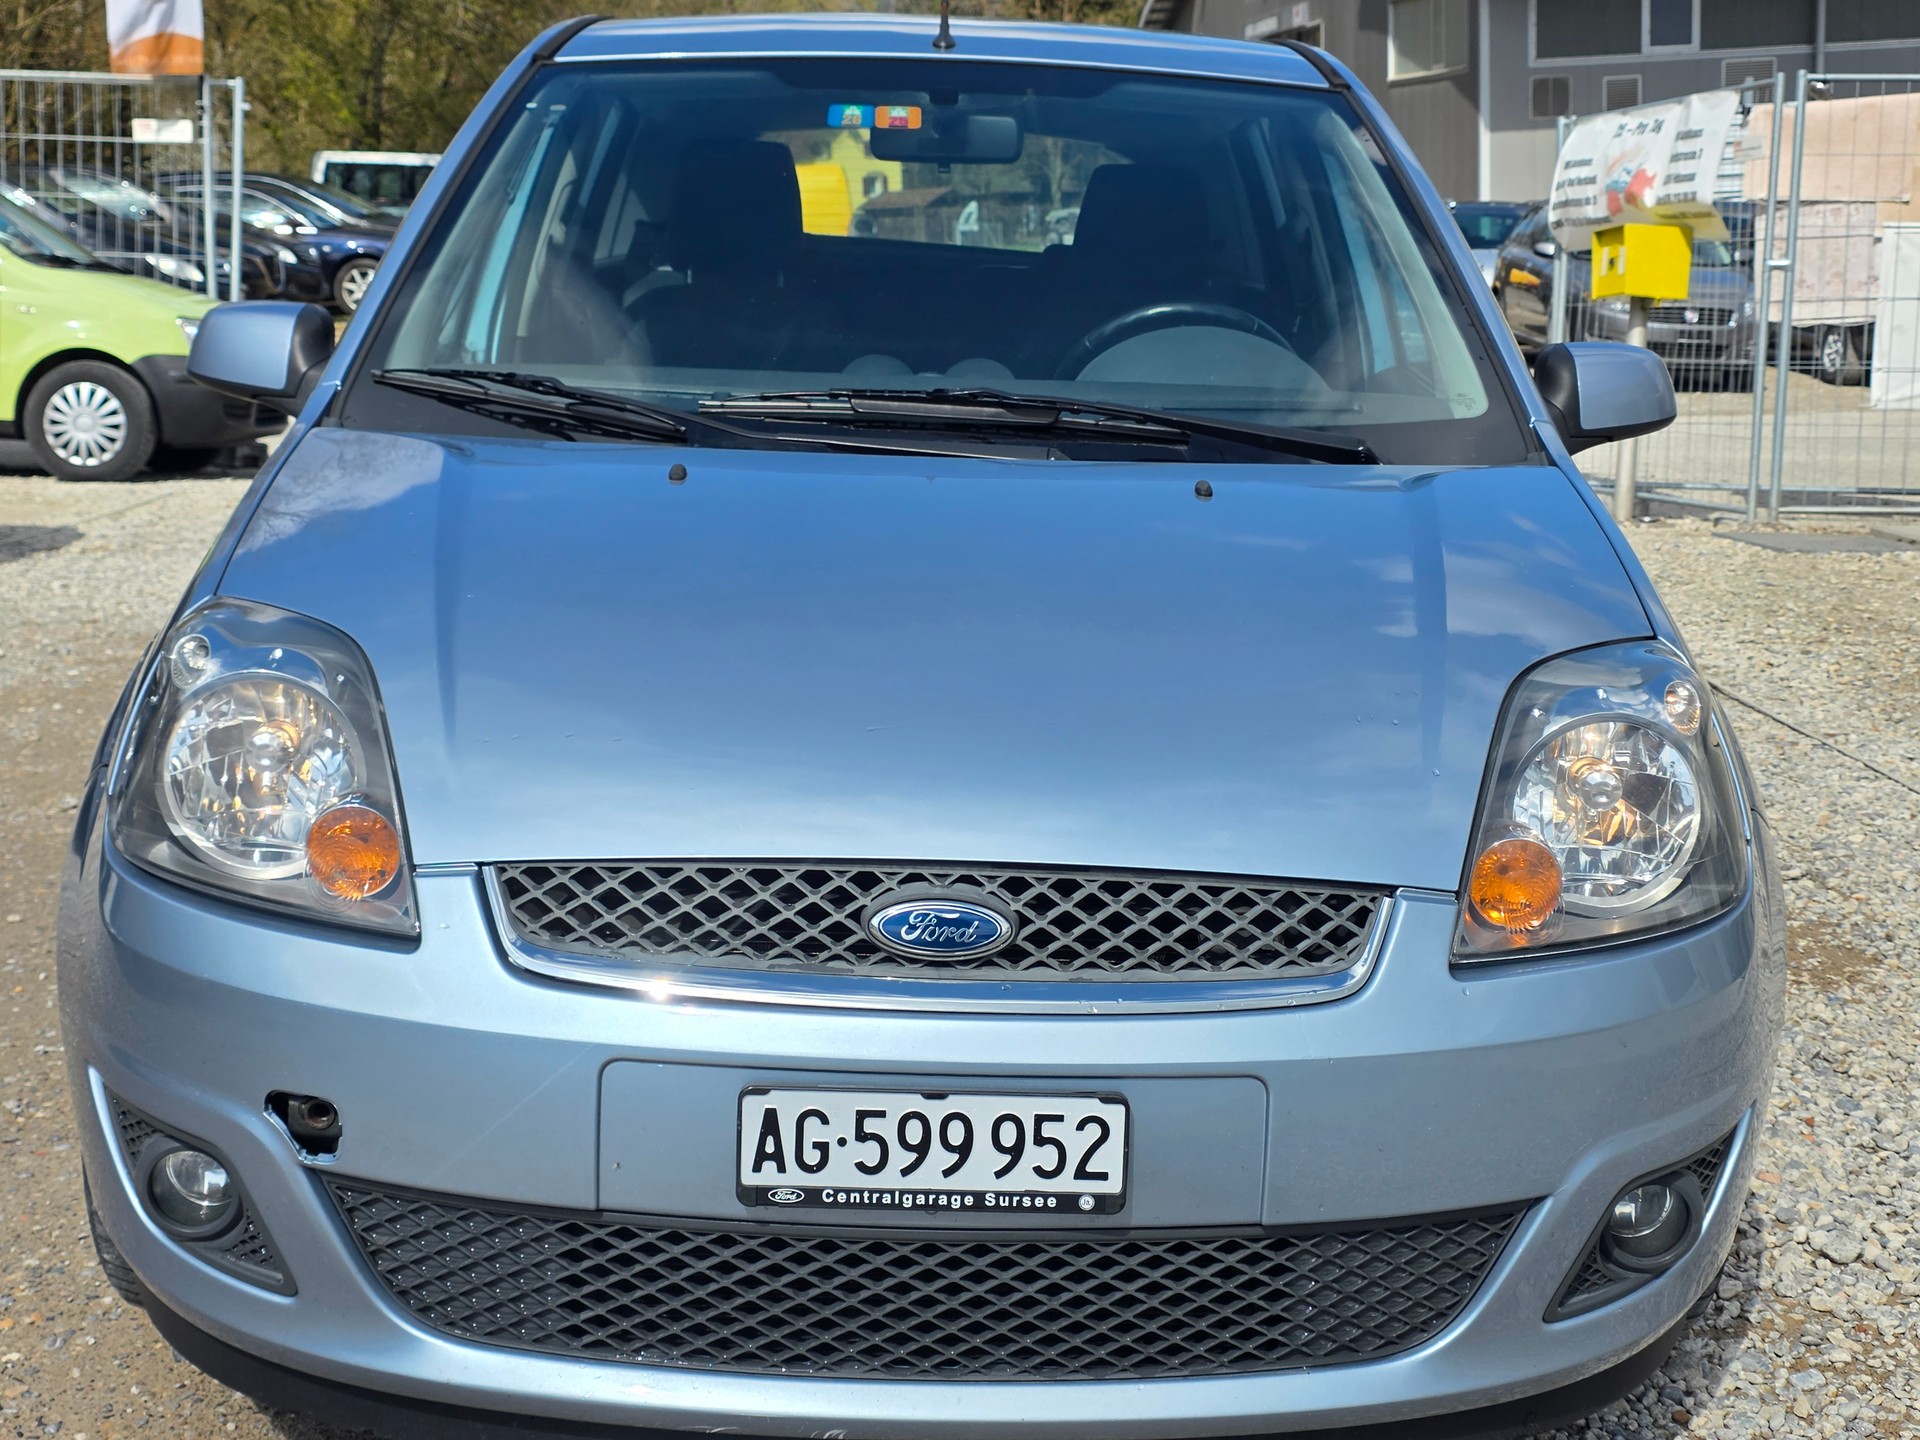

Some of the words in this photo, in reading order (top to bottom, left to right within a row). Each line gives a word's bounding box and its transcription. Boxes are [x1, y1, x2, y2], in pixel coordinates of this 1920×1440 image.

[900, 910, 979, 943] Ford
[821, 1188, 974, 1208] Centralgarage
[984, 1192, 1057, 1208] Sursee
